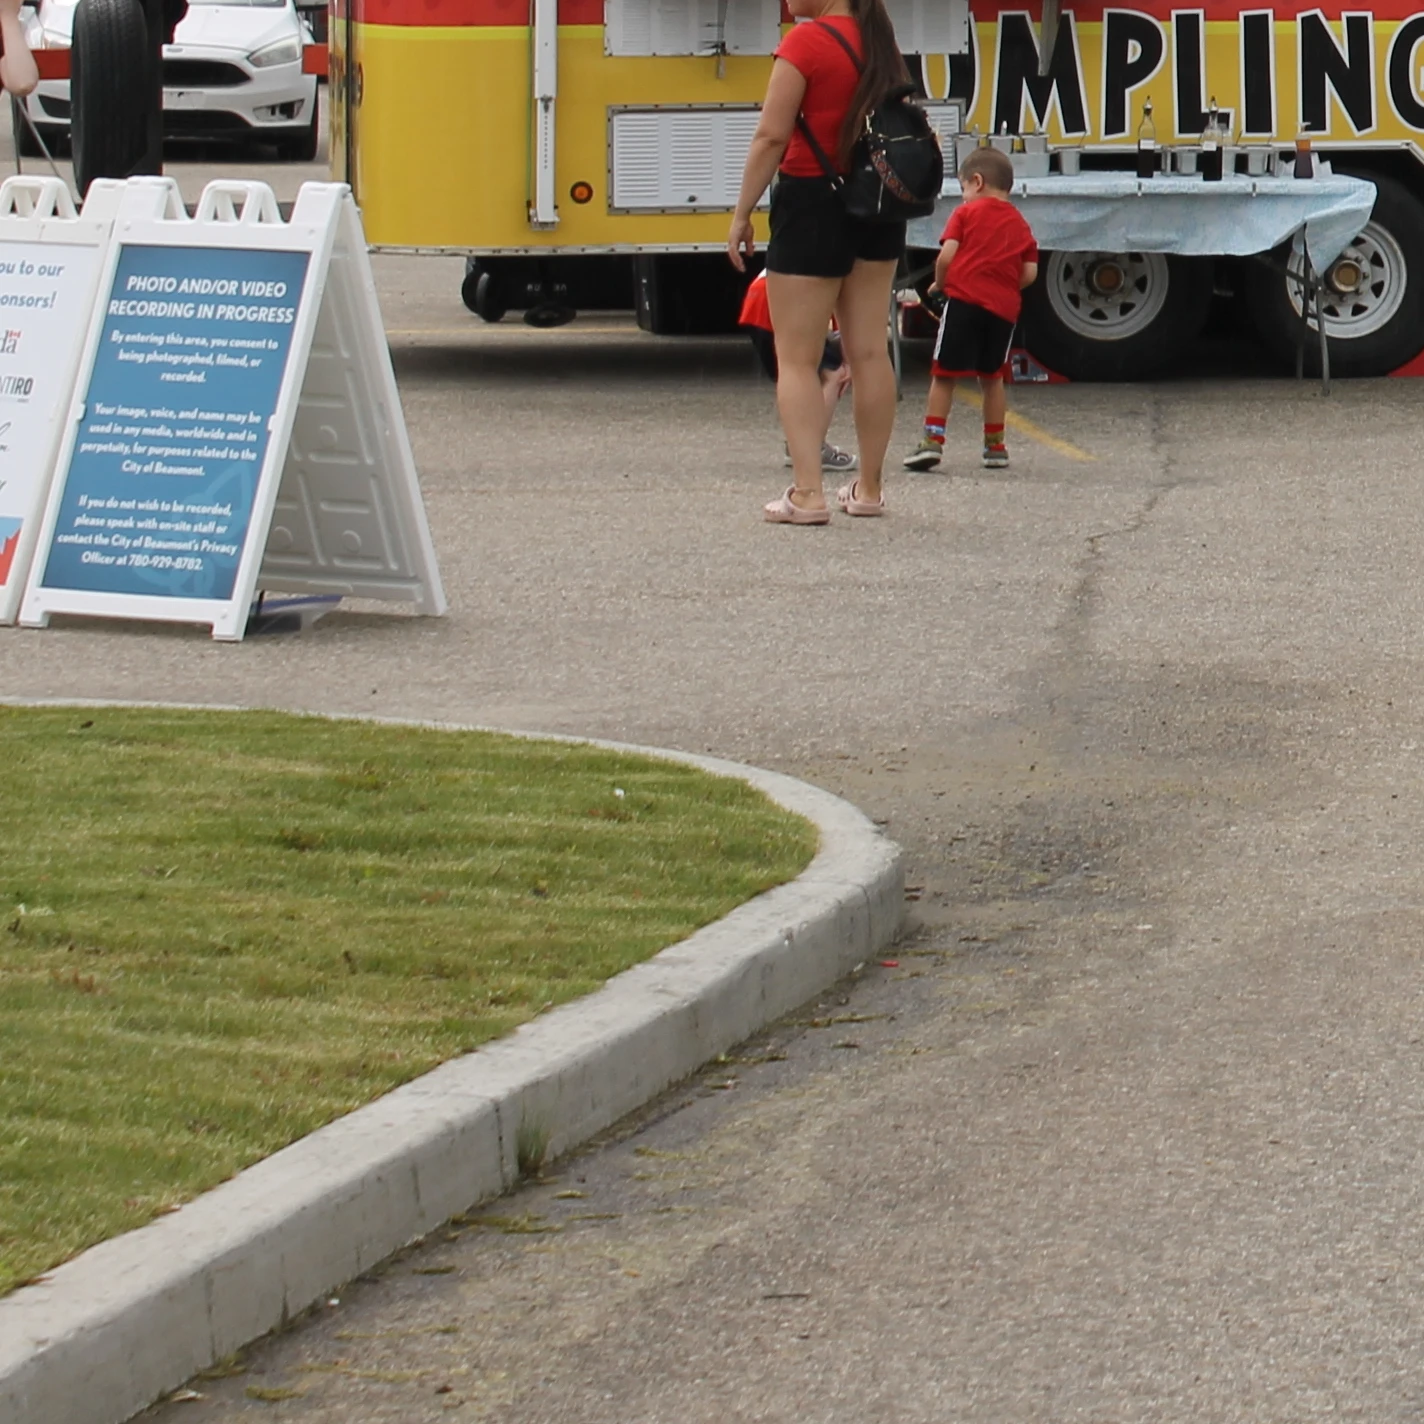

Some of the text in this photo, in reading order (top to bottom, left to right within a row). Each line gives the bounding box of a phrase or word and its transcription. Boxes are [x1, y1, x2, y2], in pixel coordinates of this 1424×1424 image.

[19, 259, 34, 275] to
[38, 264, 65, 277] our
[126, 275, 287, 298] PHOTO AND/OR VIDEO
[108, 299, 295, 324] RECORDING IN PROGRESS
[111, 329, 279, 350] By entering this area, you consent to
[118, 349, 262, 368] being photographed, filmed, or
[160, 370, 207, 383] recorded.
[95, 402, 262, 425] Your image, voice, and name may be
[89, 421, 257, 442] used in any media, worldwide and in
[80, 441, 257, 461] perpetuity, for purposes related to the
[122, 460, 206, 476] City of Beaumont.
[79, 494, 232, 517] If you do not wish to be recorded,
[74, 514, 228, 534] please speak with on-site staff or
[57, 532, 238, 556] contact the City of Beaumont's Privacy
